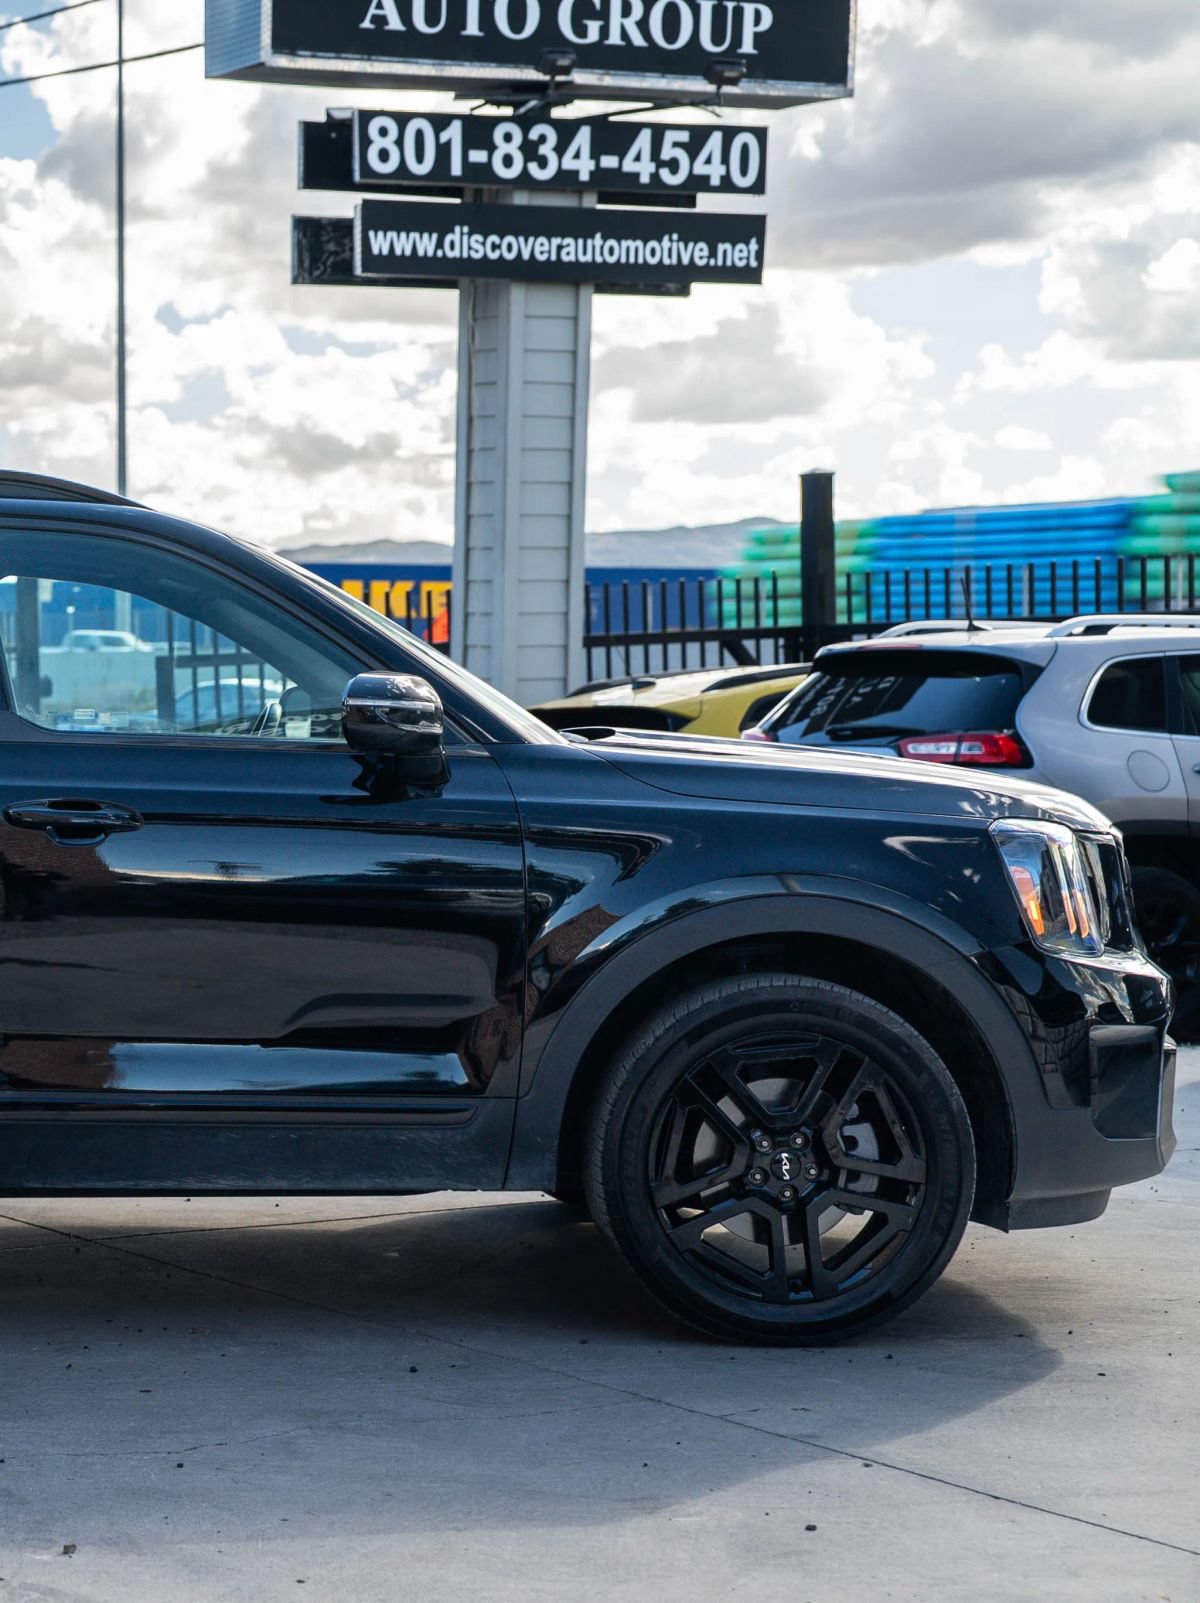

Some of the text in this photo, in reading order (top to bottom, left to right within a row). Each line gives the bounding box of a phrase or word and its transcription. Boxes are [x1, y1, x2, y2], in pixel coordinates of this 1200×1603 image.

[360, 0, 774, 54] AUTO GROUP
[366, 116, 761, 189] 801-834-4540
[368, 226, 759, 268] www.discoverautomotive.net
